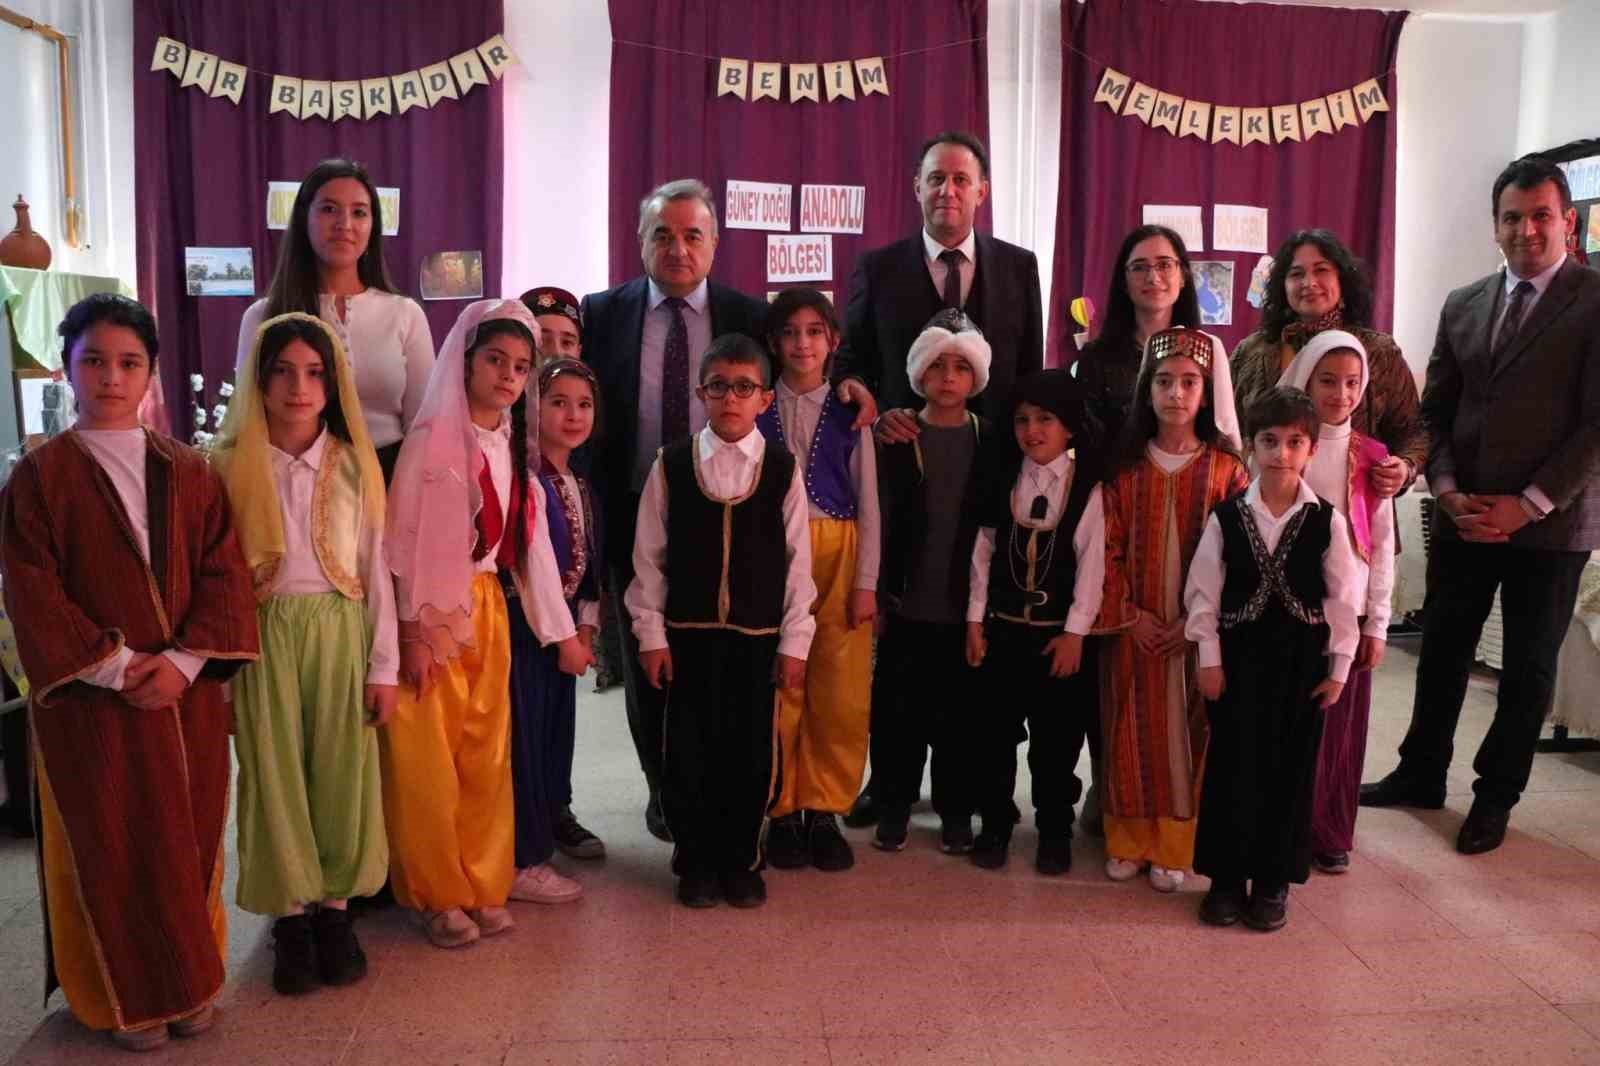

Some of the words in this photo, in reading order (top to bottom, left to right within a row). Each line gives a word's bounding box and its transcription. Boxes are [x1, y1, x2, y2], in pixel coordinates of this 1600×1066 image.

[162, 43, 239, 92] BİR
[277, 44, 510, 115] BAŞKADIR
[724, 64, 883, 91] BENİM
[1100, 77, 1383, 133] MEMLEKETİM
[727, 184, 760, 222] GÜNEY
[762, 187, 790, 226] DOĞU
[802, 186, 865, 229] ANADOLU
[768, 237, 828, 275] BÖLGESİ
